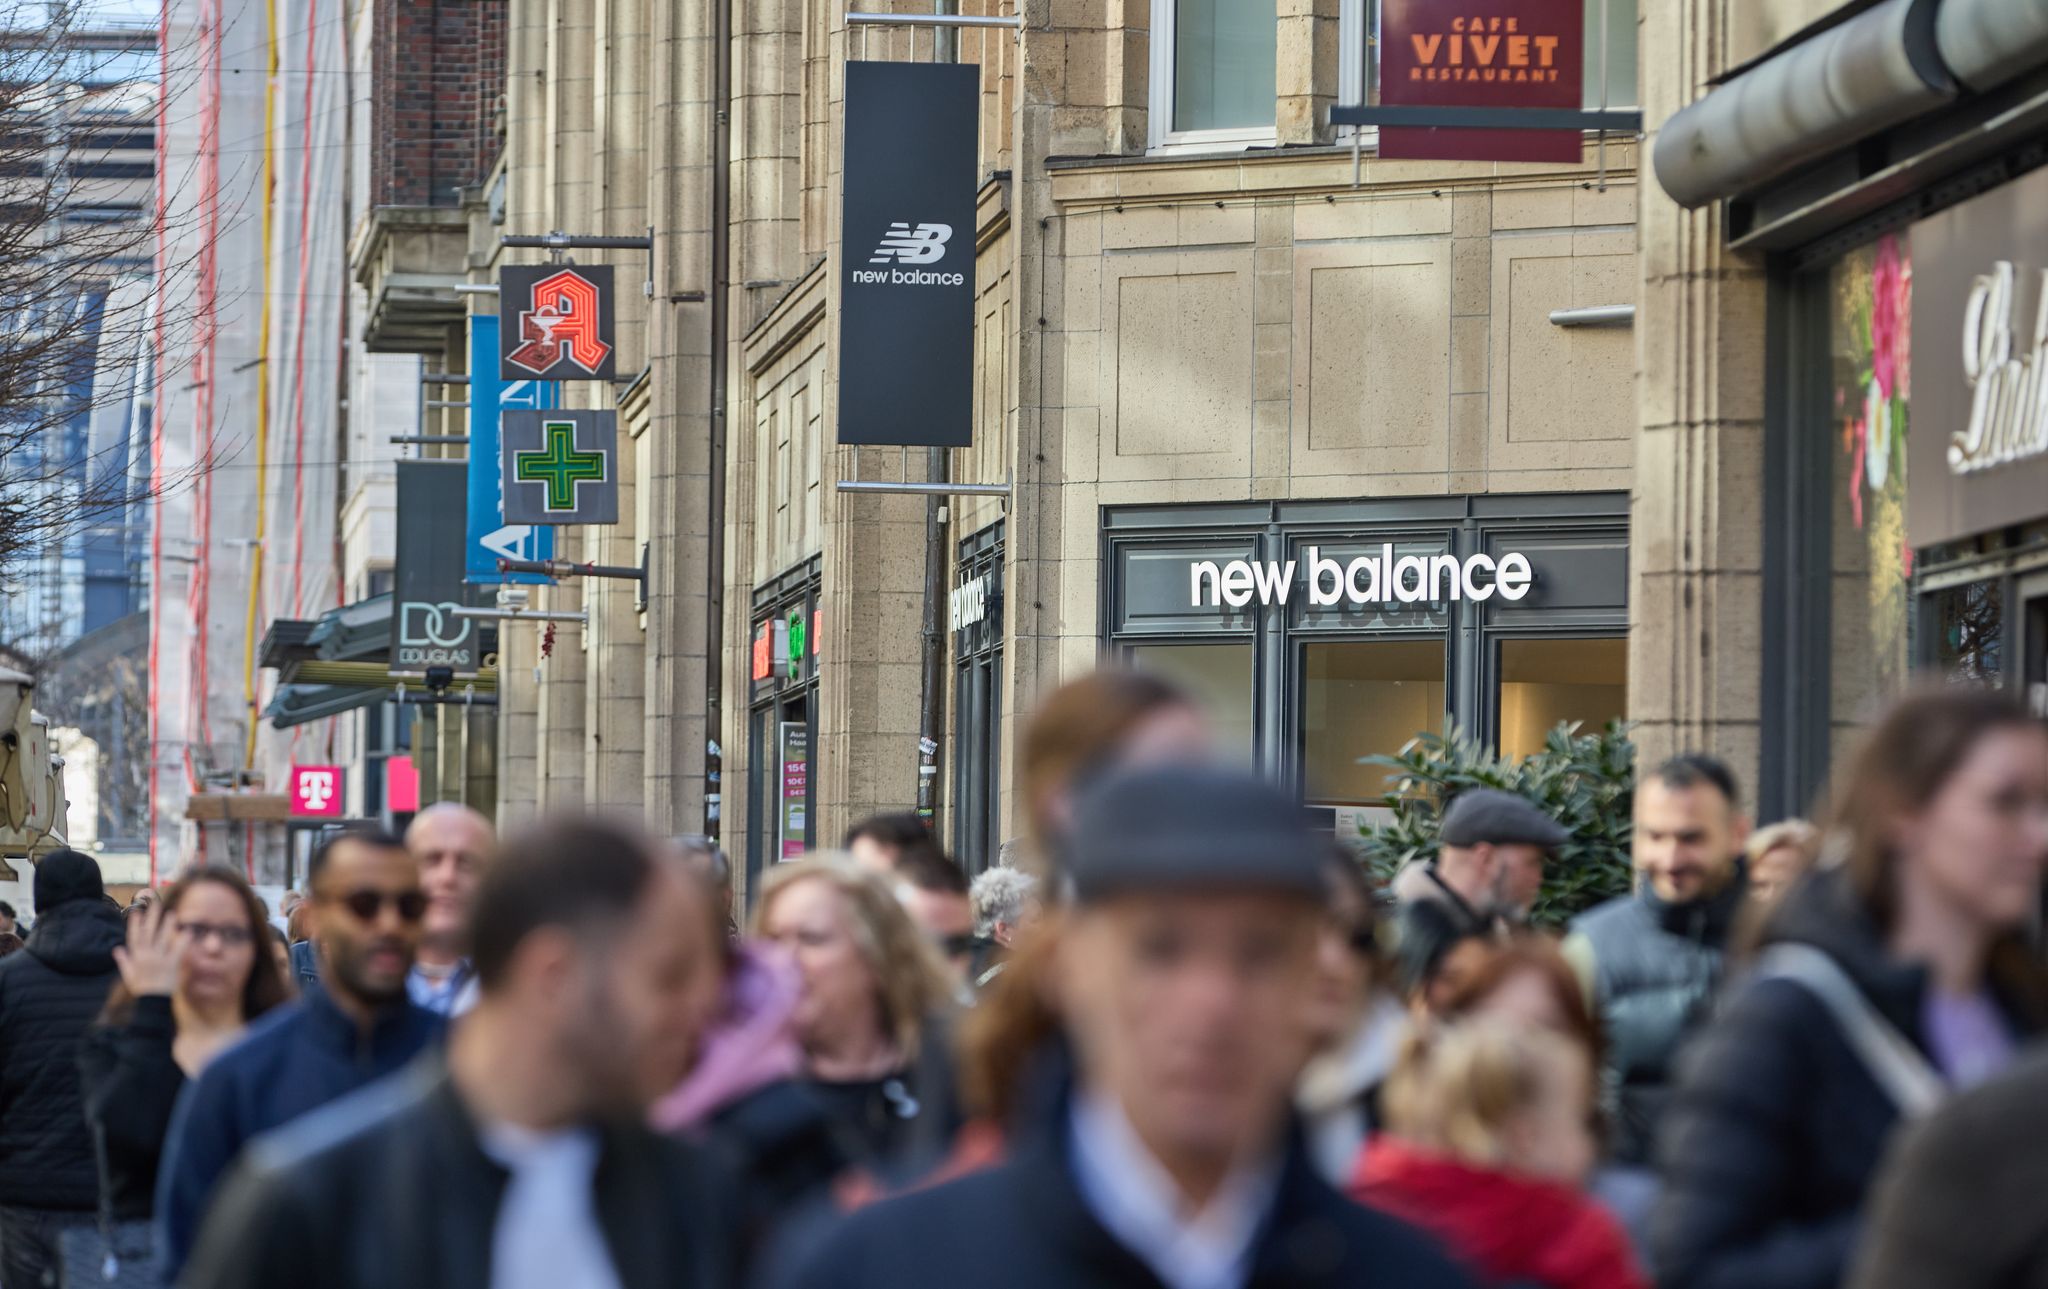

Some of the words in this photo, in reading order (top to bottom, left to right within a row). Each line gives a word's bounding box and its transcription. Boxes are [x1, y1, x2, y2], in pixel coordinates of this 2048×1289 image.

[1453, 17, 1517, 32] CAFE
[1412, 34, 1558, 66] VIVET
[1411, 68, 1558, 81] RESTAURANT
[852, 270, 889, 284] new
[892, 268, 964, 286] balance
[1191, 559, 1296, 607] new
[1309, 543, 1532, 606] balance
[400, 648, 470, 664] DOUGLAS
